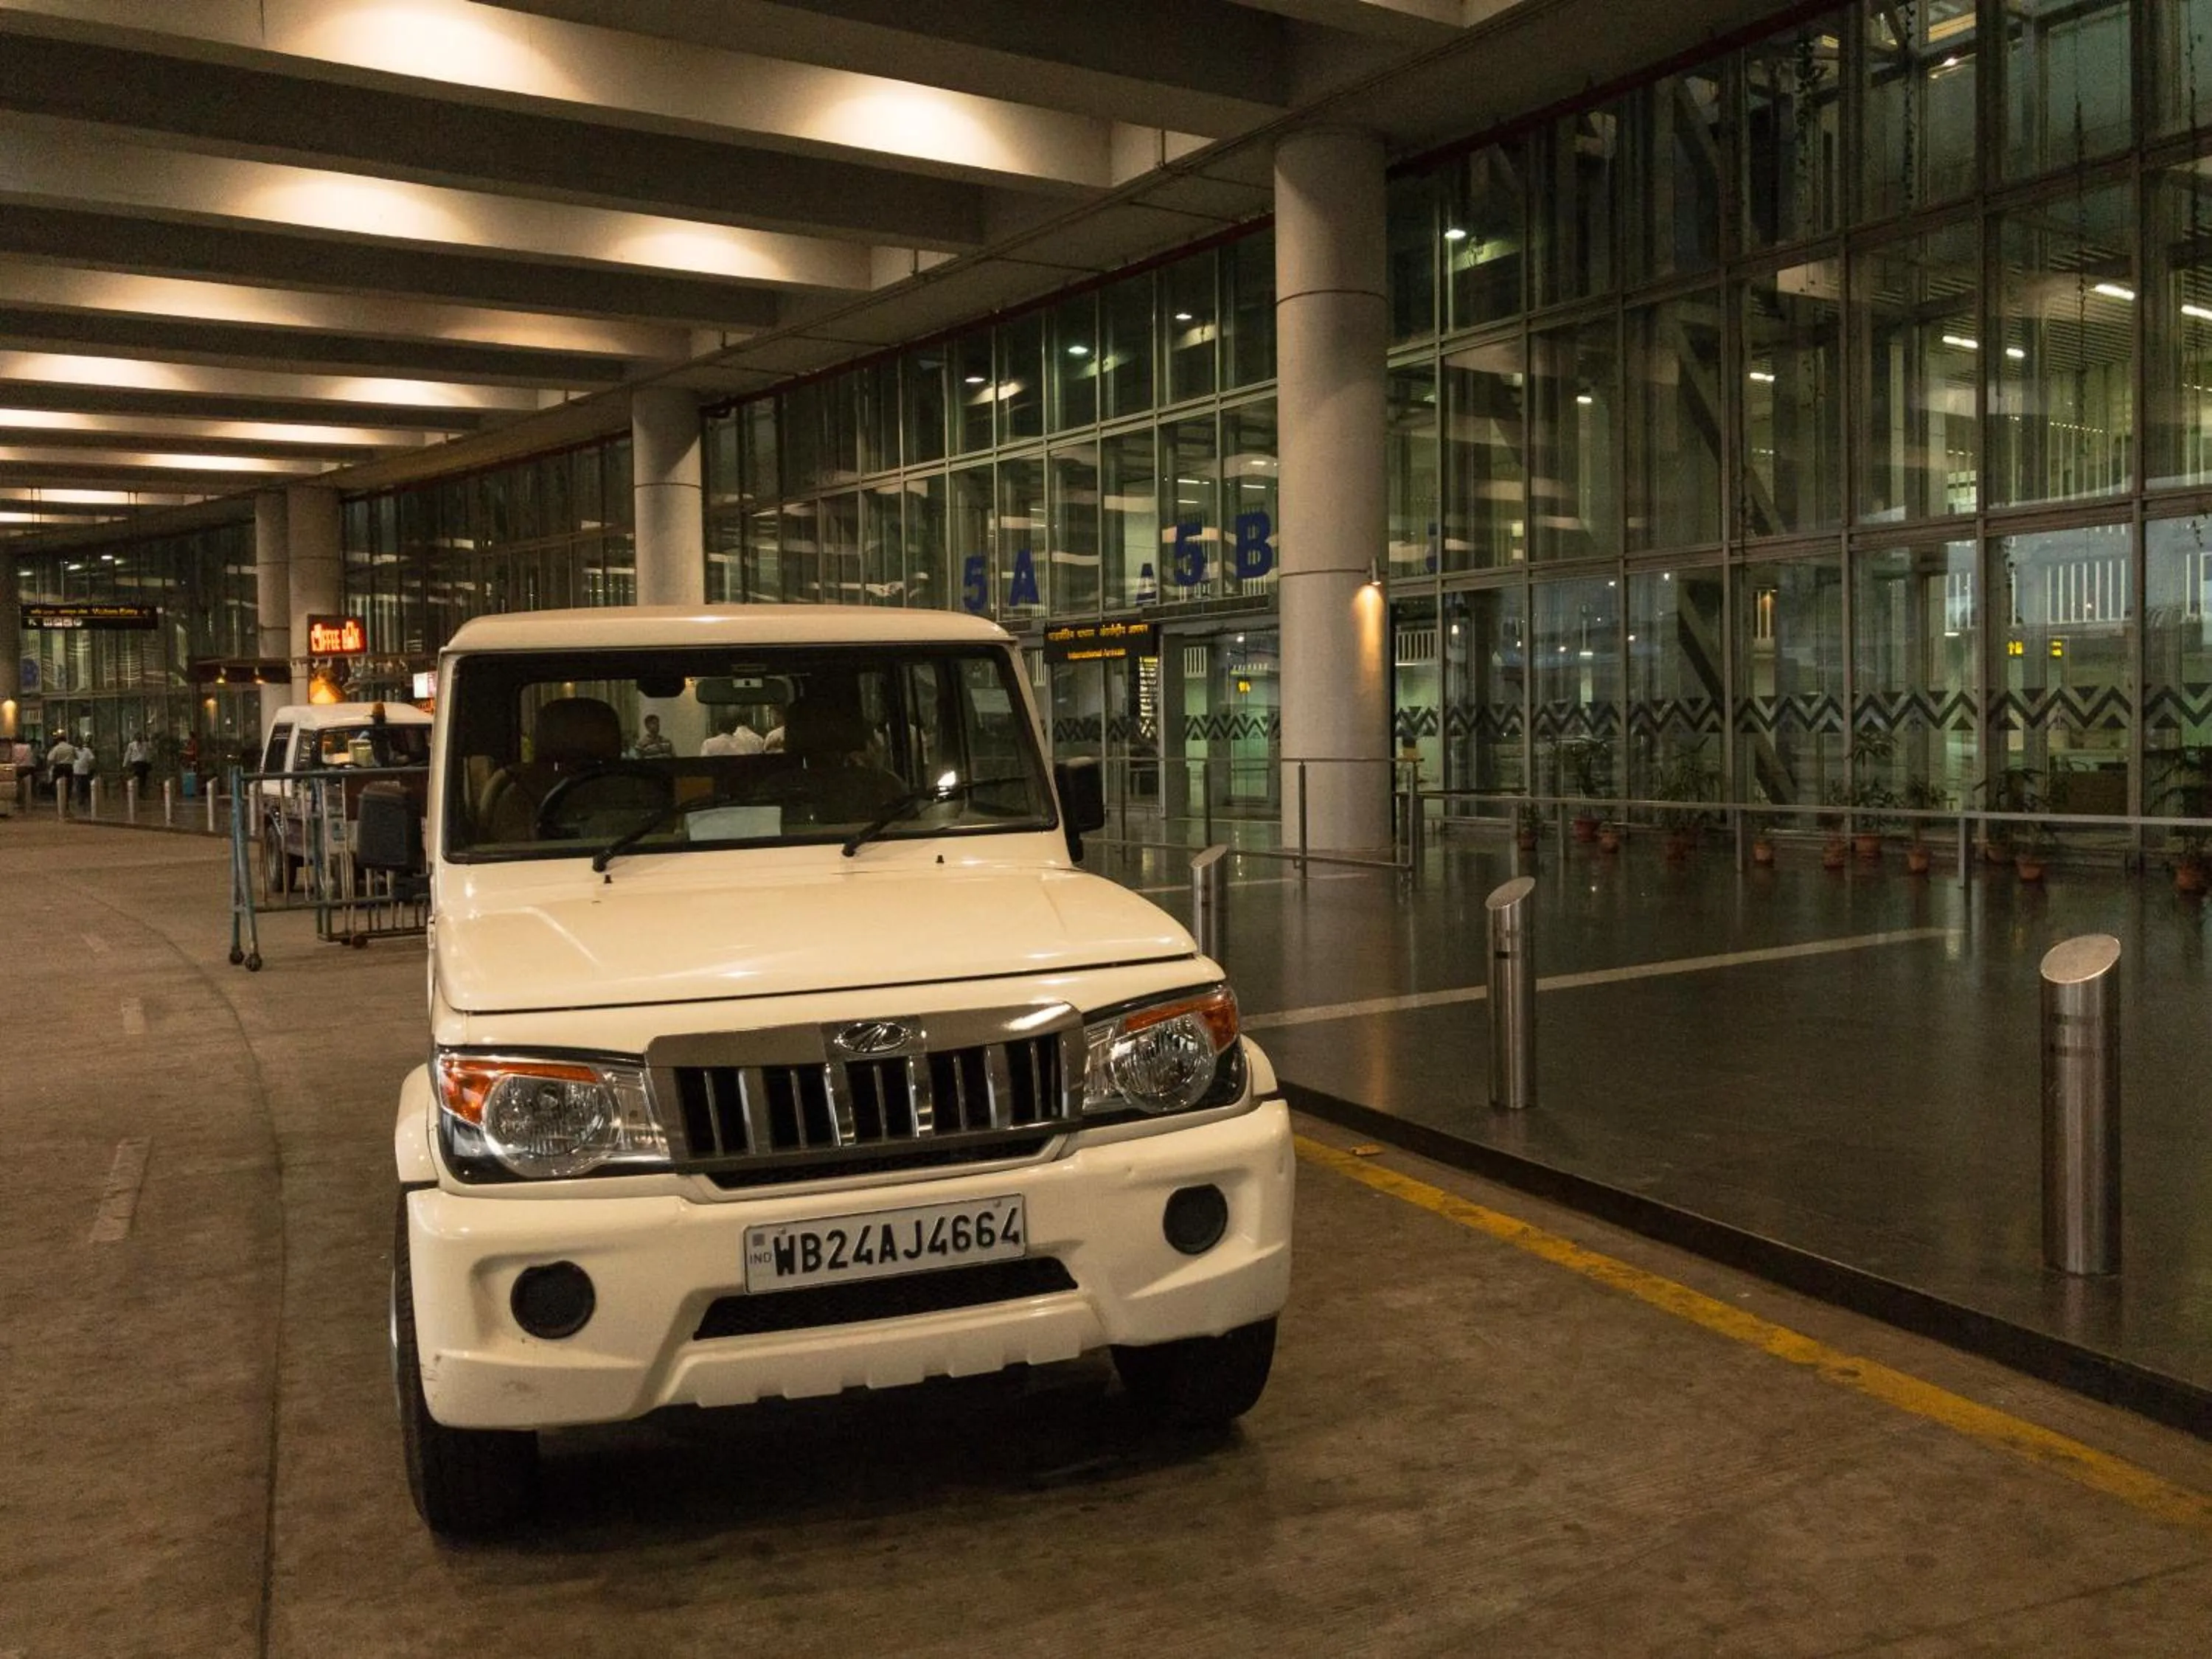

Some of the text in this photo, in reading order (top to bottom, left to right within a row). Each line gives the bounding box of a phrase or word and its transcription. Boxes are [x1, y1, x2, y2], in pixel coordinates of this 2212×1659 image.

[310, 624, 341, 653] COFFEE
[749, 1207, 1020, 1277] IND WB24AJ4664
